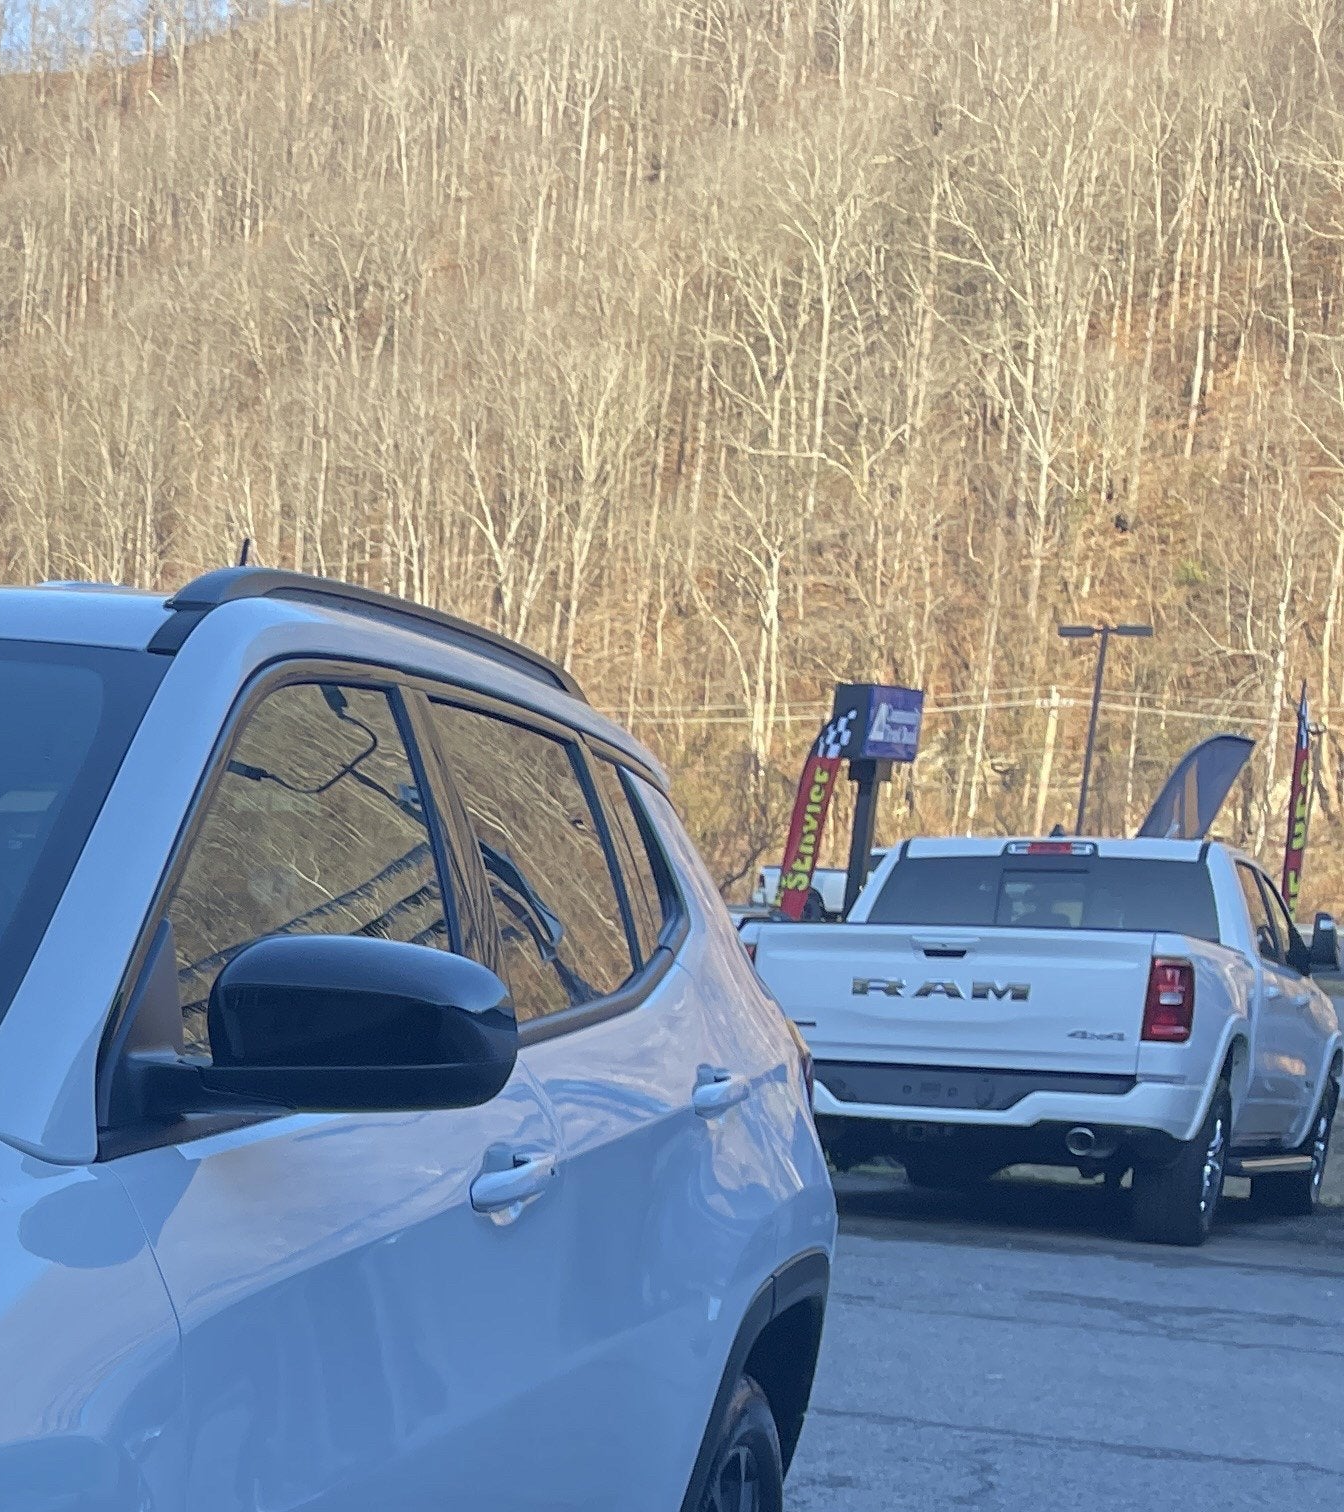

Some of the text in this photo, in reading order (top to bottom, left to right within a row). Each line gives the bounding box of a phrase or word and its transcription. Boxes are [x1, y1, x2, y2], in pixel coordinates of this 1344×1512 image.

[782, 766, 830, 891] SERVICE
[851, 976, 1031, 1002] RAM
[1067, 1029, 1125, 1041] 4x4
